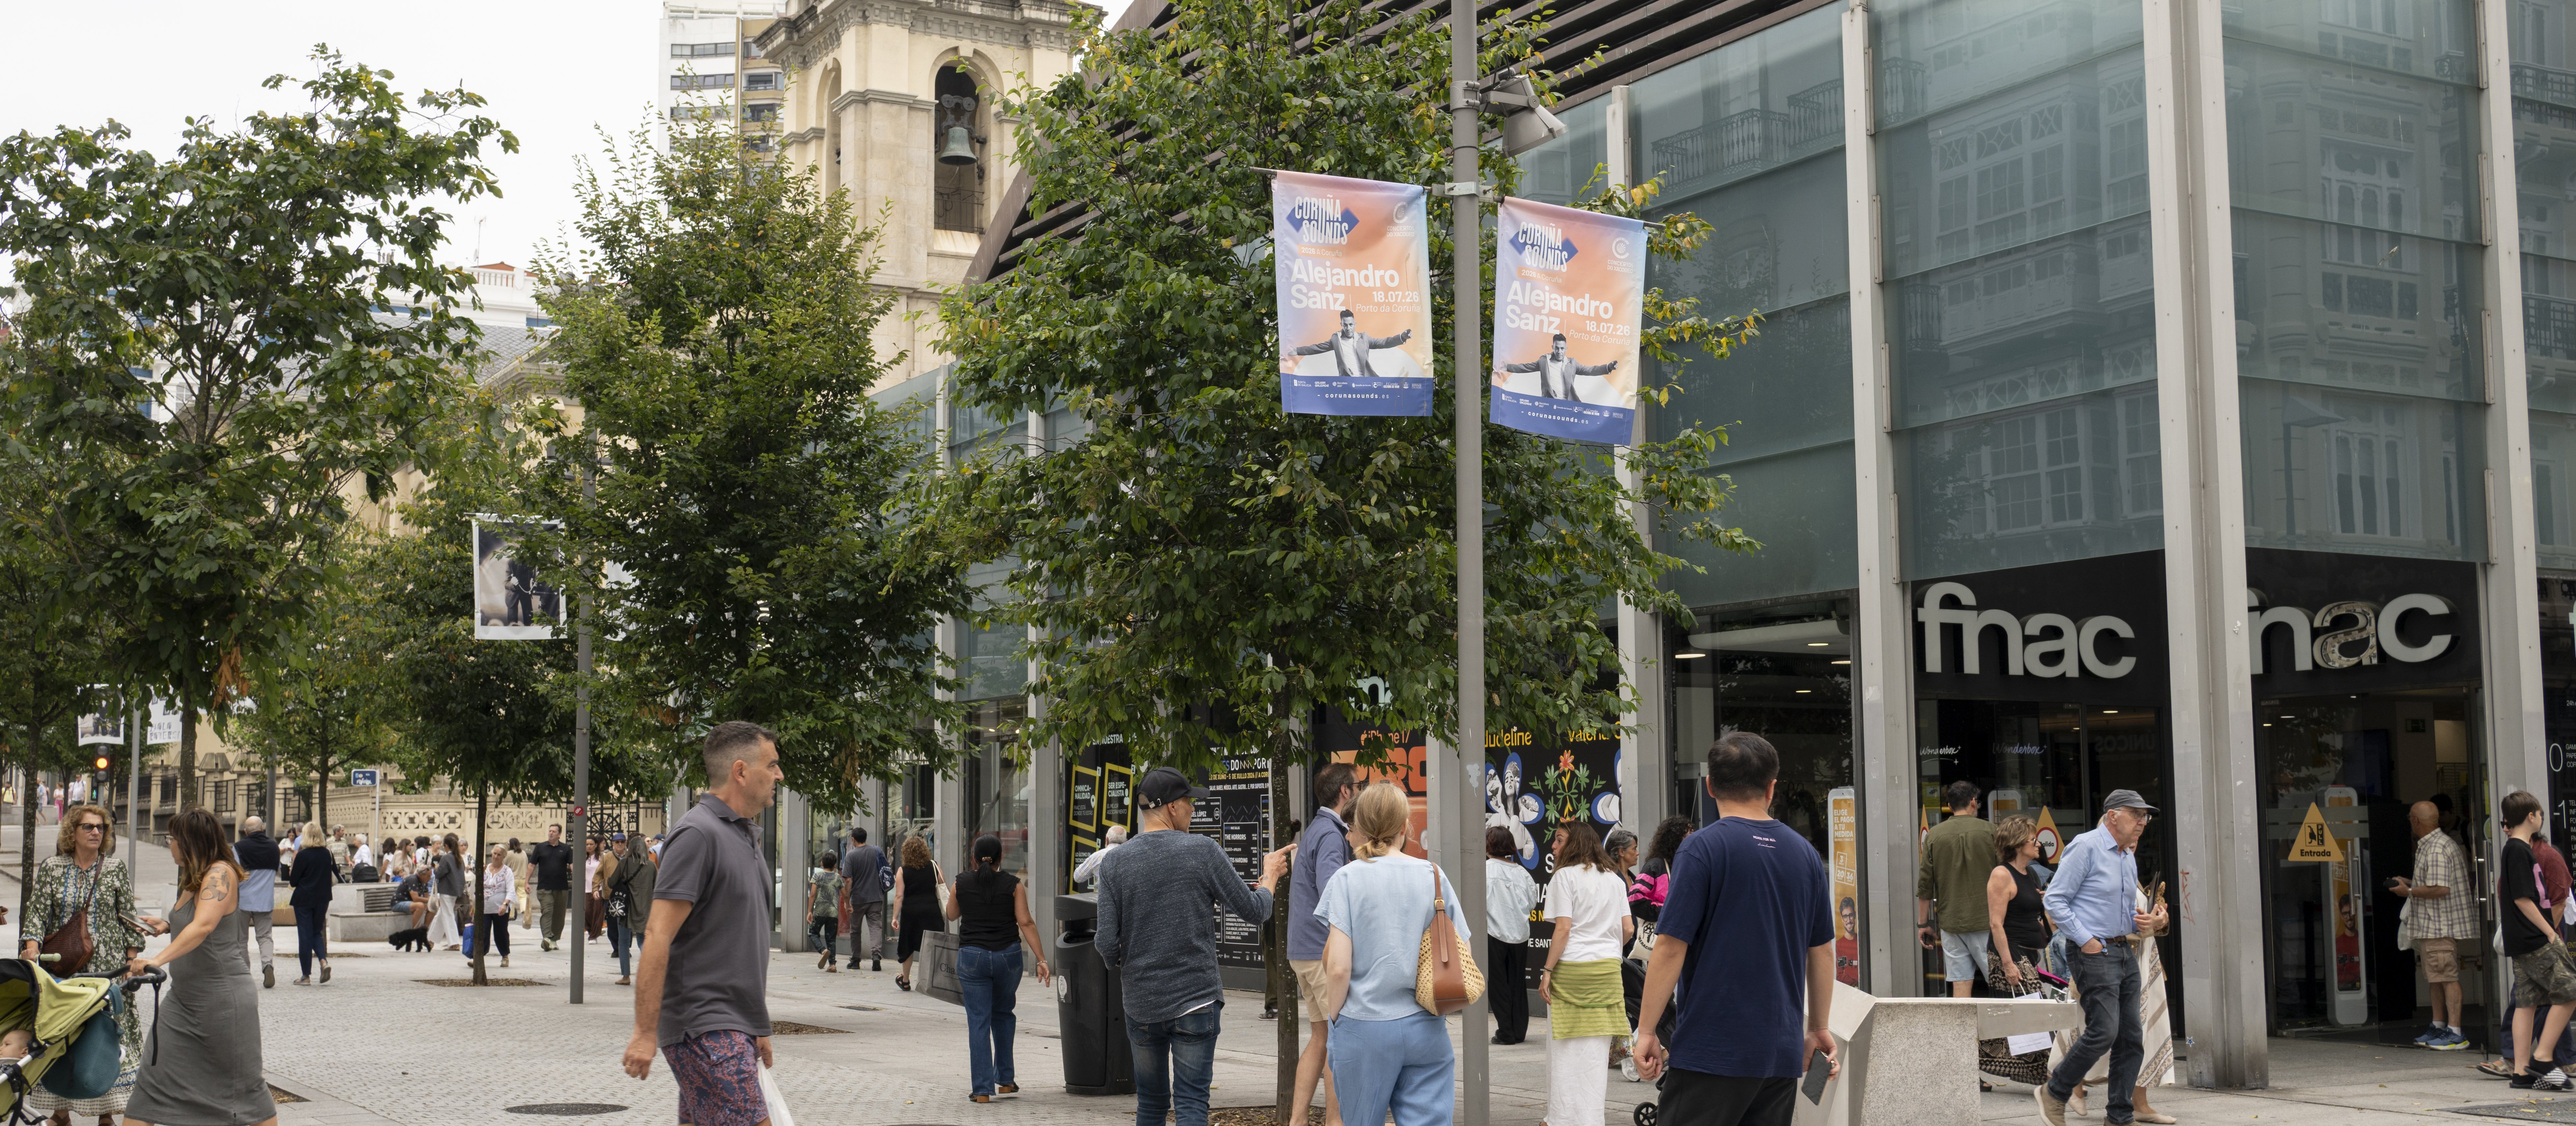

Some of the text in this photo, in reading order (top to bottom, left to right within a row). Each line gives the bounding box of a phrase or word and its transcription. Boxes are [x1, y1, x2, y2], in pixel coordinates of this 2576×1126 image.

[1295, 194, 1341, 221] CORUÑA
[1302, 220, 1348, 245] SOUNDS
[1518, 222, 1562, 250] CORUÑA
[1525, 244, 1568, 272] SOUNDS
[1608, 259, 1633, 268] CONCERTOS
[1290, 258, 1399, 291] Alejandro
[1542, 274, 1562, 283] Coruña
[1291, 284, 1346, 311] Sanz
[1356, 303, 1420, 313] Porto da Coruña
[1372, 291, 1419, 302] 18.07.26
[1507, 280, 1613, 319] Alejandro
[1506, 304, 1560, 335] Sanz
[1586, 320, 1630, 336] 18.07.26
[1569, 330, 1630, 346] Porto da Coruña
[1528, 412, 1589, 424] corunasounds.es
[1917, 581, 2136, 679] fnac
[2247, 588, 2452, 675] nac
[1231, 760, 1239, 770] DO
